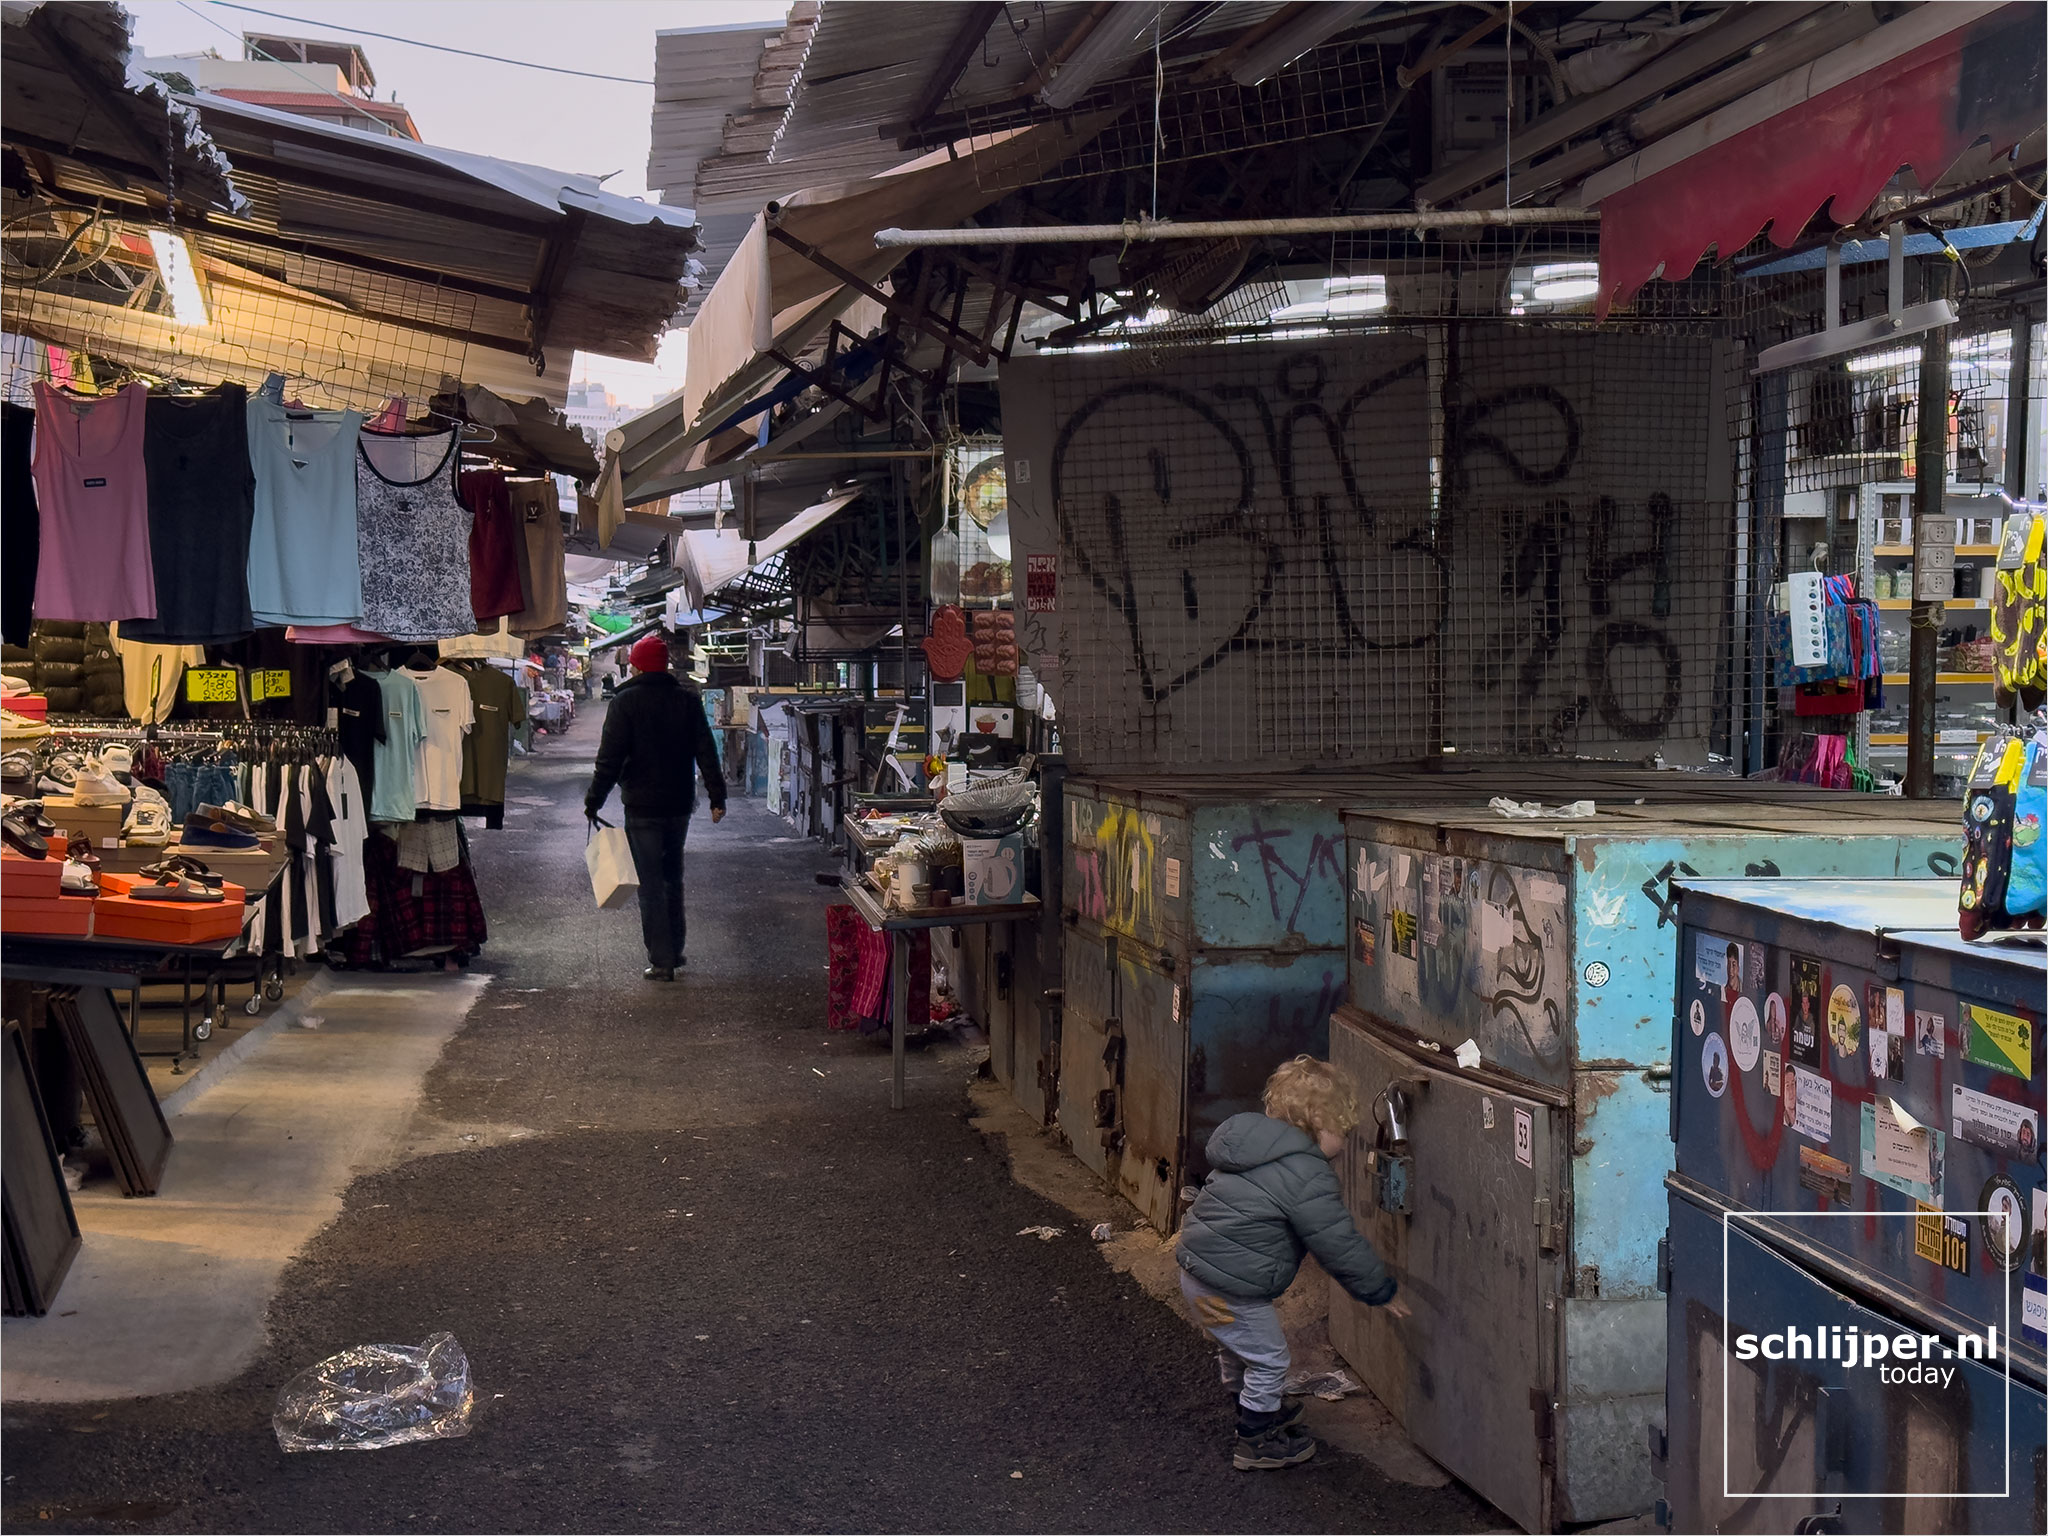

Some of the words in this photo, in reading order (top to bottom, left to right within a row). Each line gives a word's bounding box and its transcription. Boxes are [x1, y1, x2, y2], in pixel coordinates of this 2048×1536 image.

[1028, 557, 1056, 572] אתה
[1793, 1030, 1815, 1049] נשמה
[1518, 1122, 1528, 1150] 53
[1944, 1234, 1967, 1273] 101
